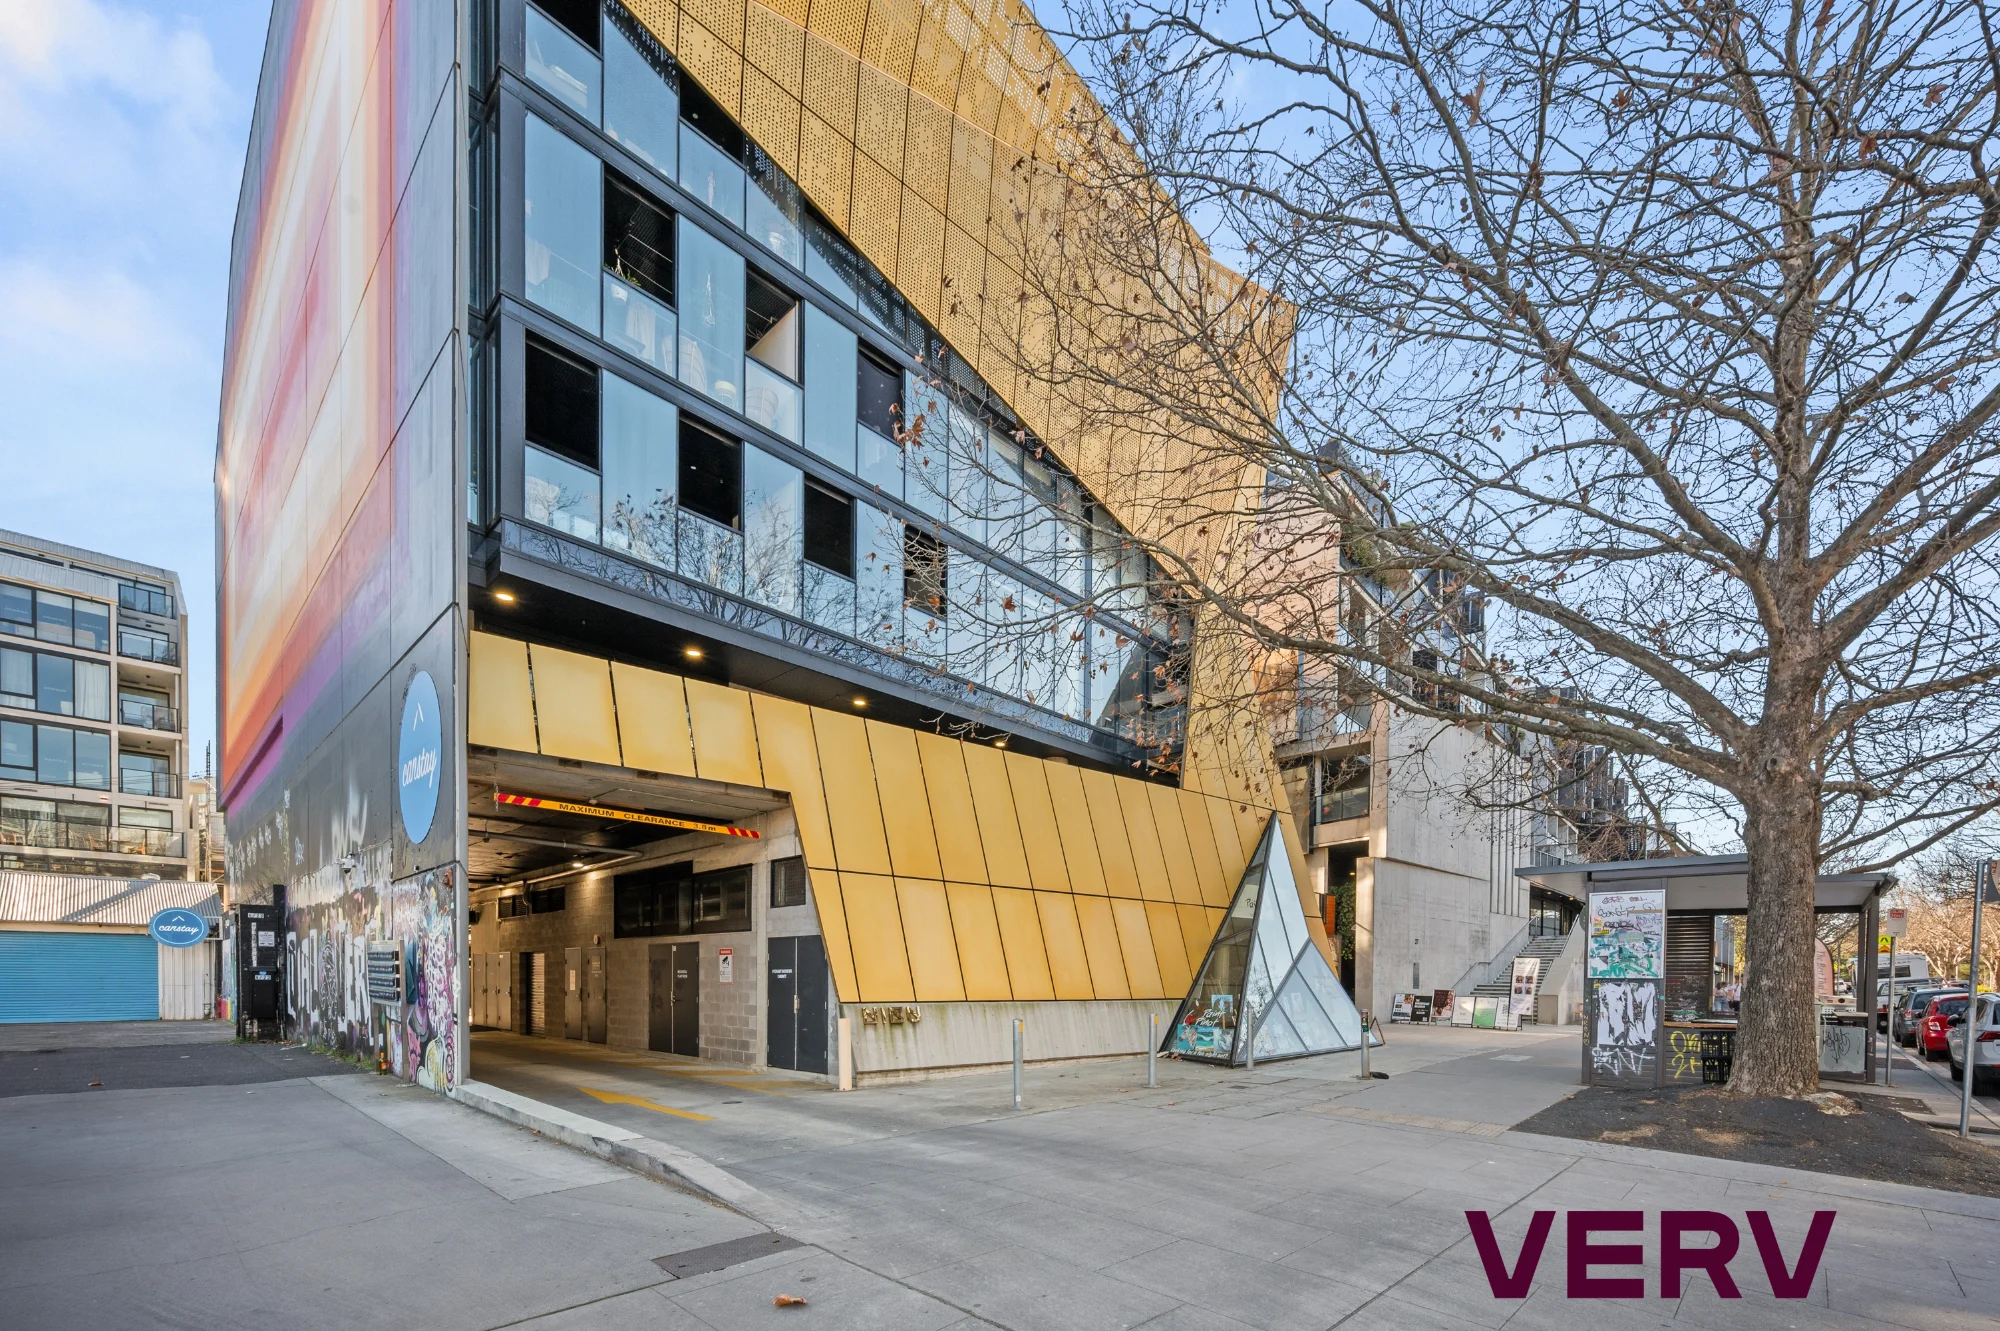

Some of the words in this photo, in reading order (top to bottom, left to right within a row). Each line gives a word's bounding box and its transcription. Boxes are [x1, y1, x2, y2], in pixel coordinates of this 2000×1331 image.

[402, 748, 437, 789] canstay
[558, 803, 615, 817] MAXIMUM
[623, 813, 685, 828] CLEARANCE
[158, 925, 199, 935] canstay
[1203, 1008, 1226, 1019] Paint
[1195, 1018, 1220, 1027] Pinot
